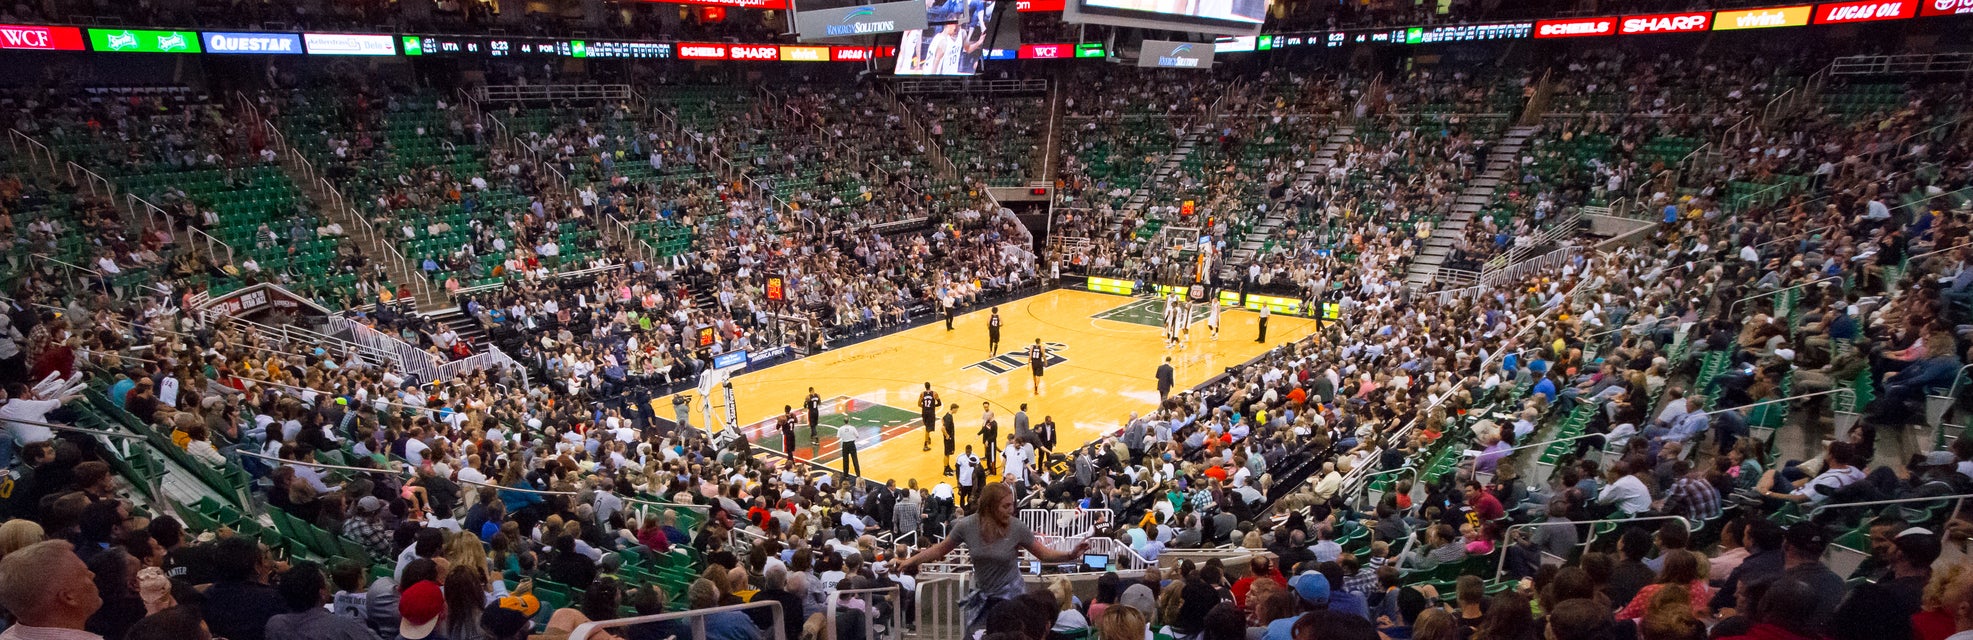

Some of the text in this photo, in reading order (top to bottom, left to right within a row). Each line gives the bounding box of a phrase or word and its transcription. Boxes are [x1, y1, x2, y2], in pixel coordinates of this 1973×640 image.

[1826, 1, 1901, 21] LUCAS OIL
[1540, 21, 1611, 35] SCHEELS
[2, 29, 48, 47] WCF
[211, 35, 291, 51] QUESTAR
[1287, 37, 1301, 45] UTA
[1372, 33, 1388, 41] POR
[442, 42, 459, 51] UTA
[468, 43, 477, 52] 61
[539, 45, 553, 53] POR
[838, 49, 861, 59] LUCAS
[1034, 47, 1057, 57] WCF
[1465, 512, 1480, 527] 15
